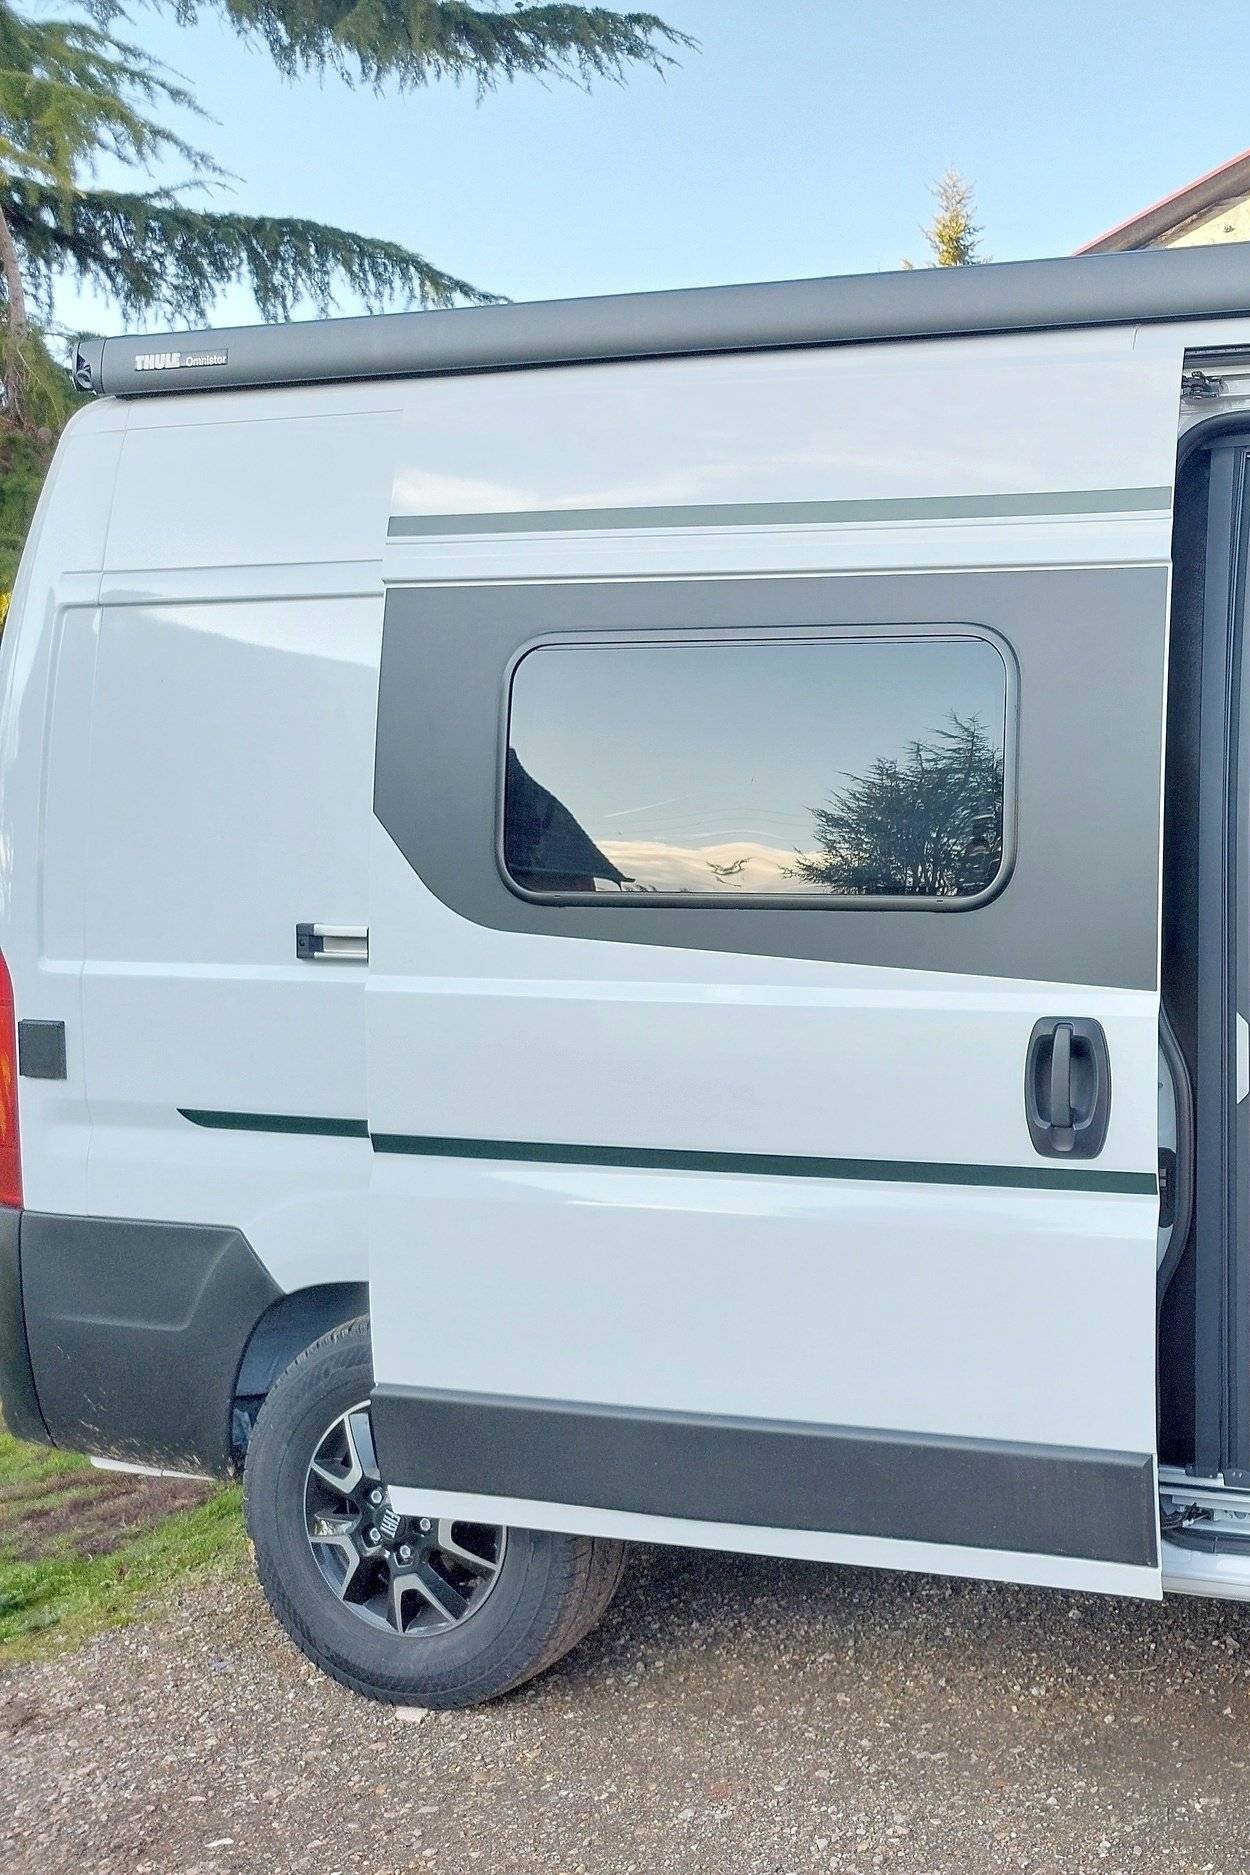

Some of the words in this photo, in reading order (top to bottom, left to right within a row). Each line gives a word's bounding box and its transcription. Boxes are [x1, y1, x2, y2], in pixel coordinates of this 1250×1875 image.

[135, 352, 181, 371] THULE
[185, 354, 228, 367] Omnistor
[379, 1508, 401, 1539] FIAT
